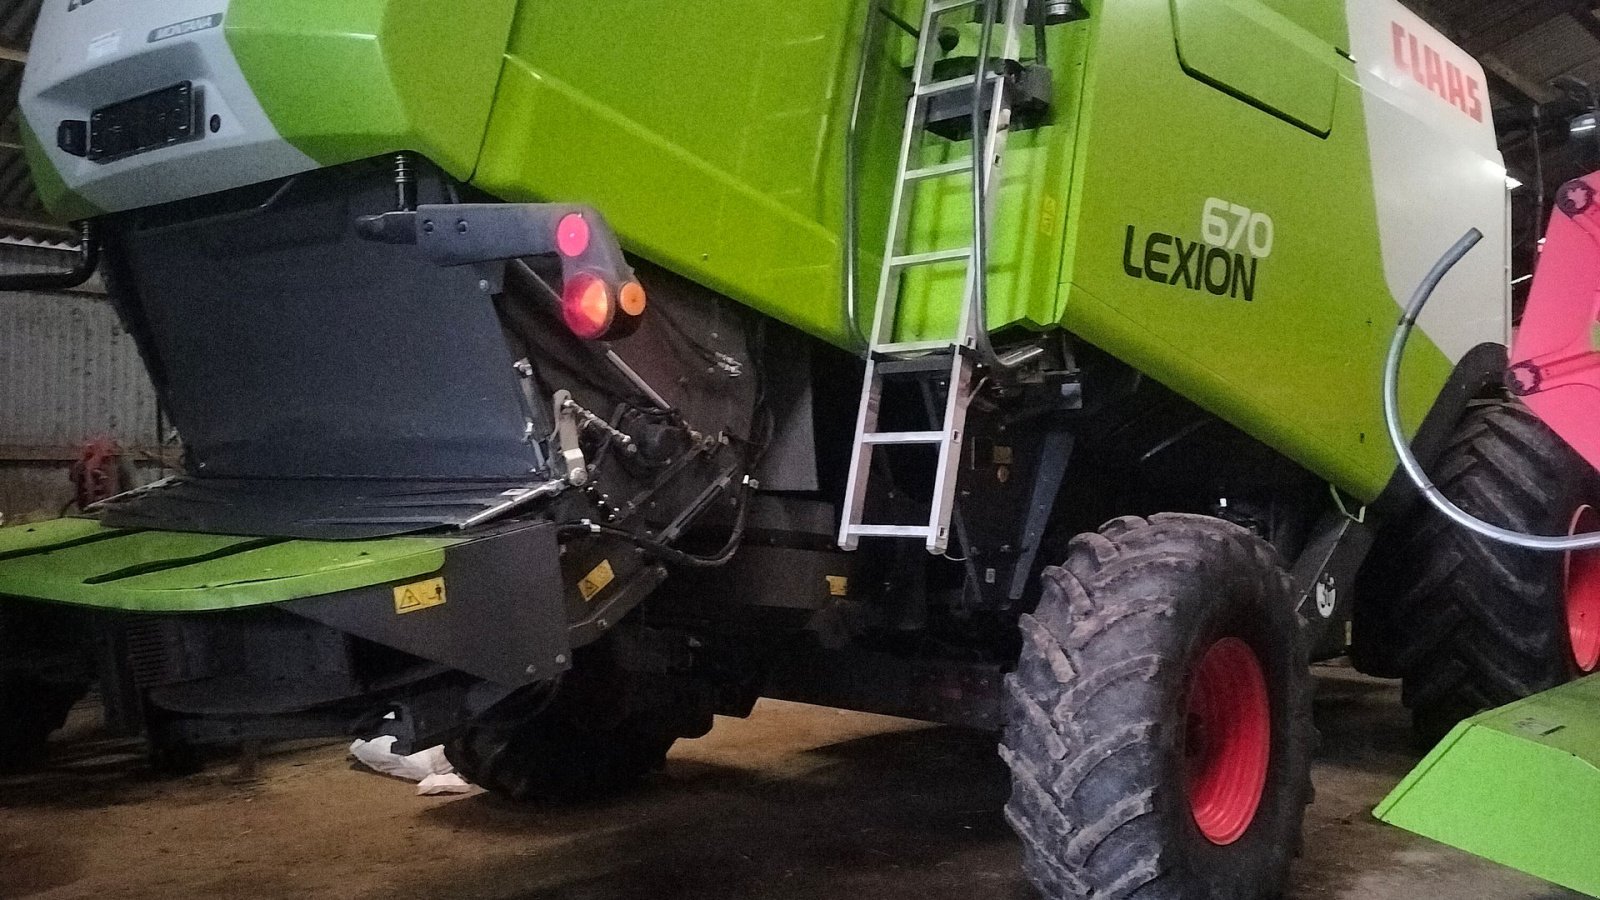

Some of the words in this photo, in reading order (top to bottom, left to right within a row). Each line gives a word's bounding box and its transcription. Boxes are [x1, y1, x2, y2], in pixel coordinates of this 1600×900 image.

[1391, 21, 1483, 123] CLAAS
[1123, 224, 1257, 302] LEXION
[1202, 197, 1274, 258] 670
